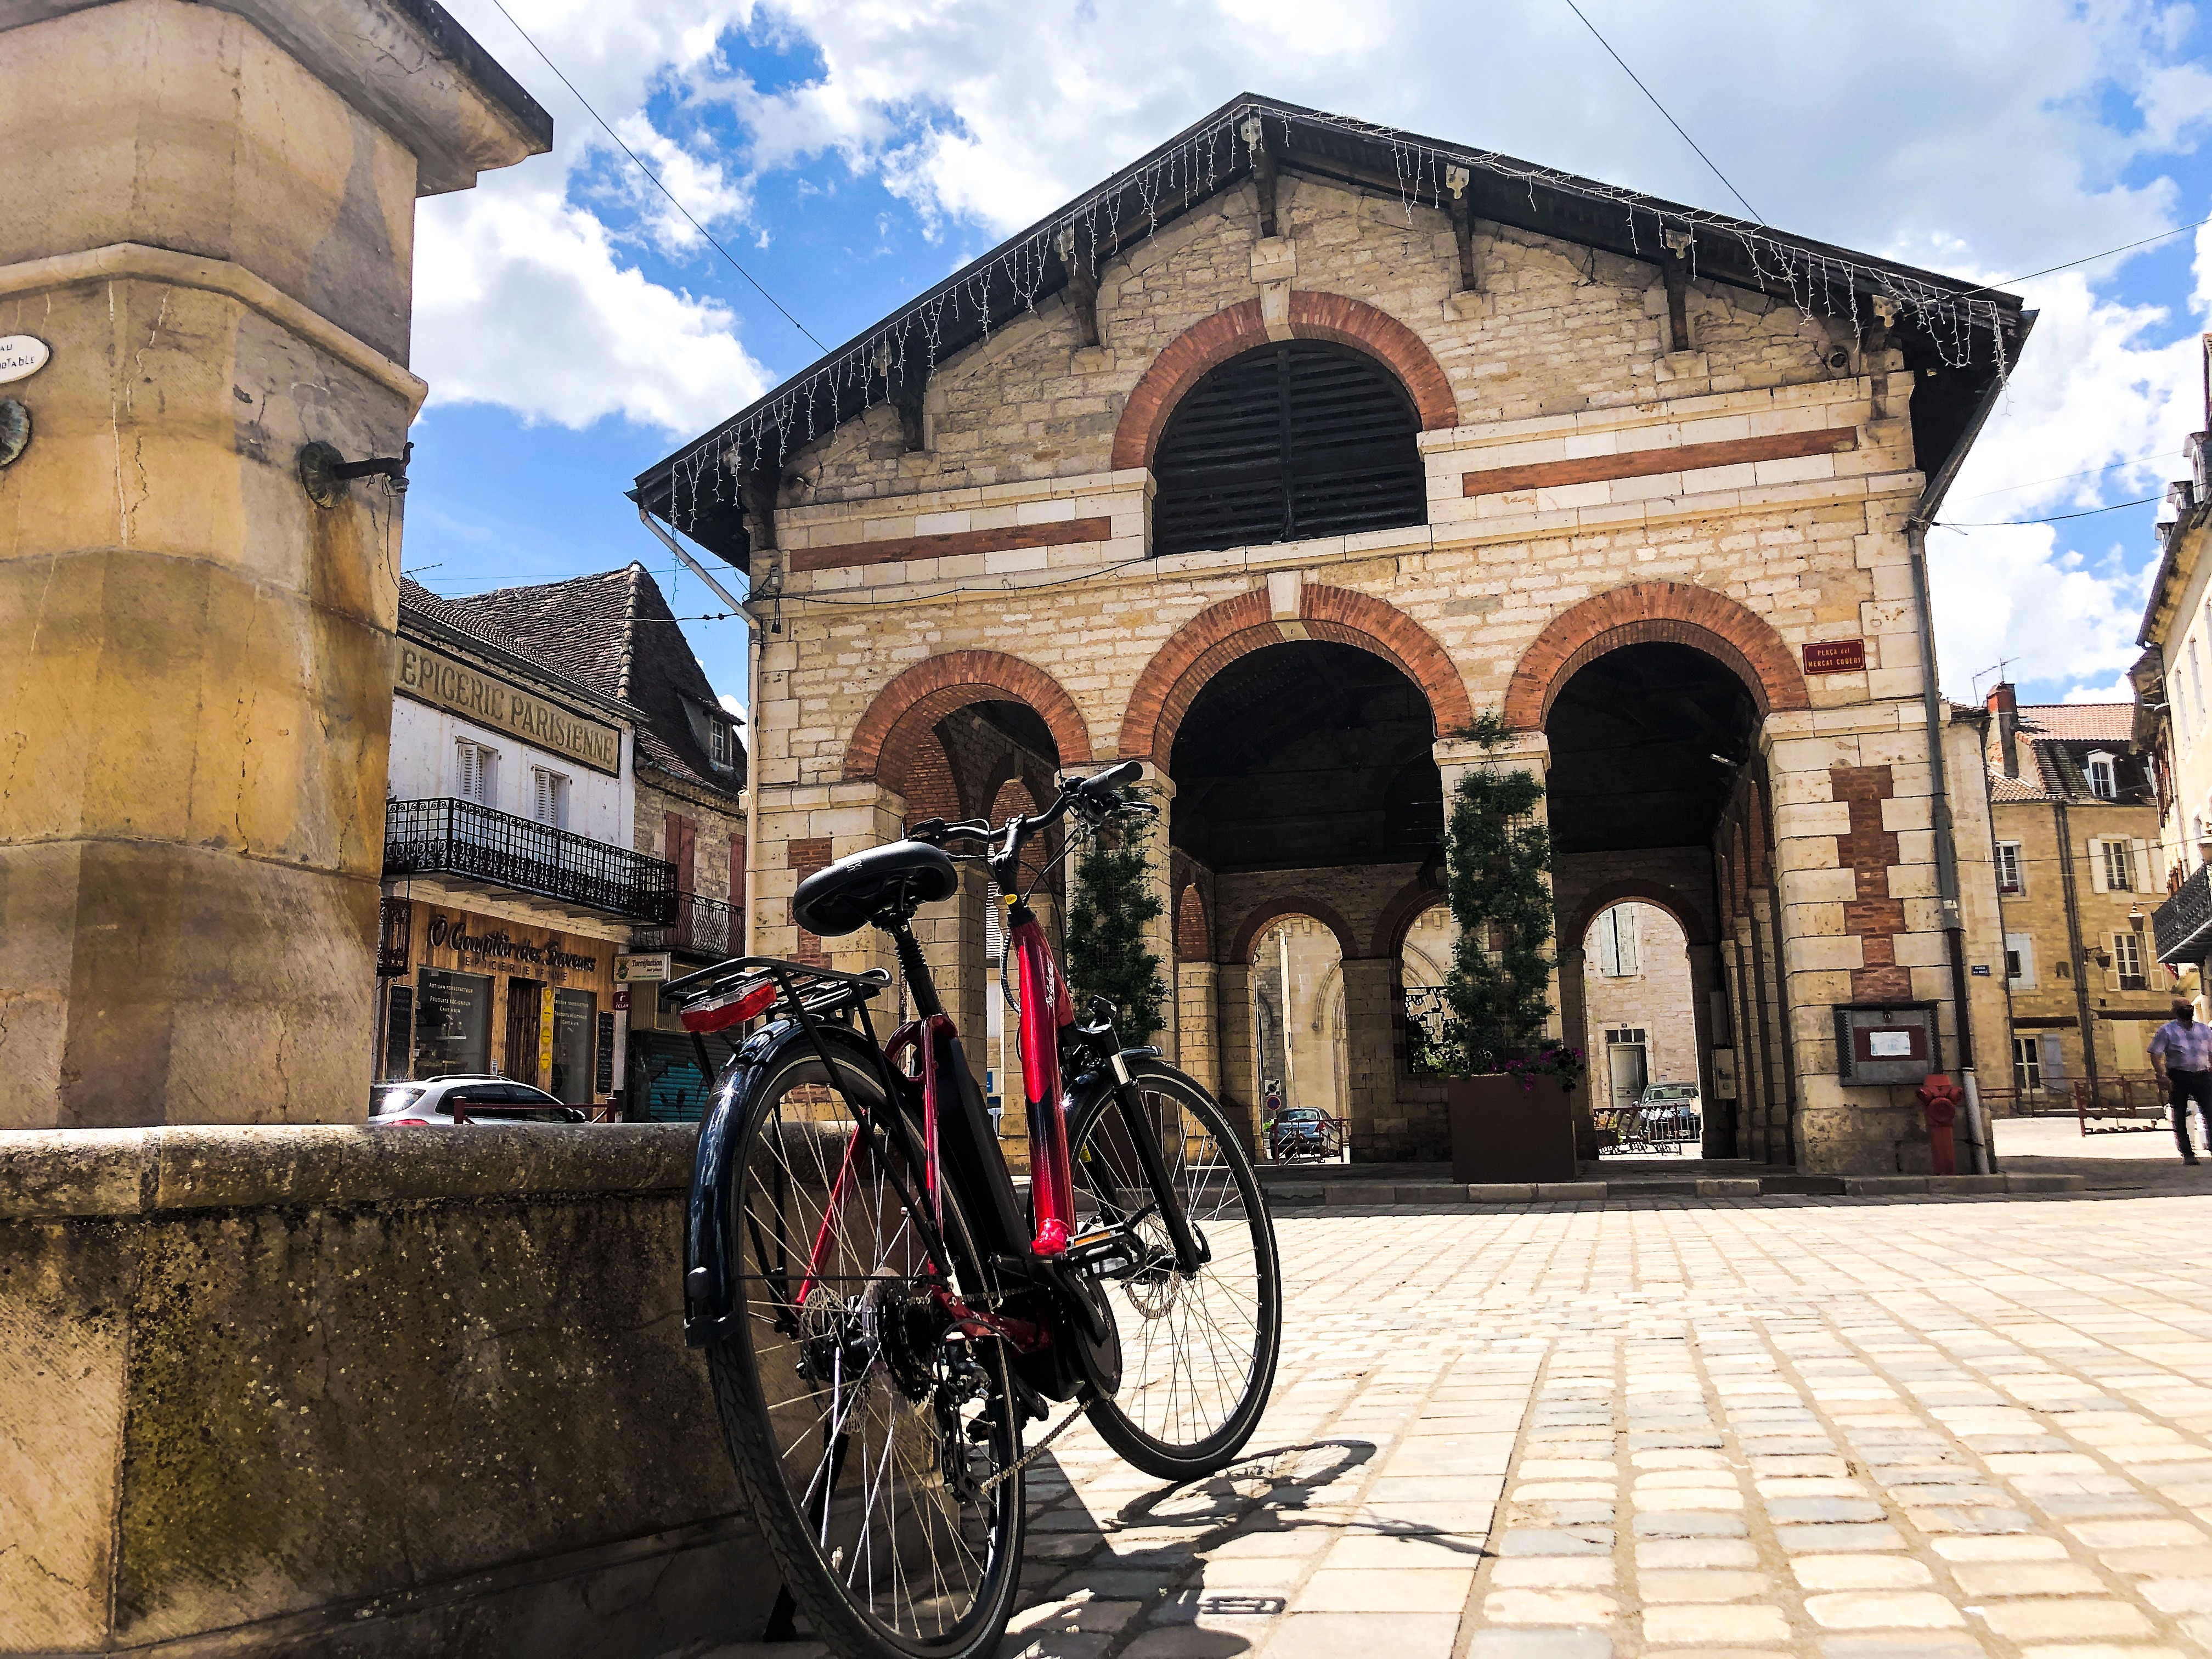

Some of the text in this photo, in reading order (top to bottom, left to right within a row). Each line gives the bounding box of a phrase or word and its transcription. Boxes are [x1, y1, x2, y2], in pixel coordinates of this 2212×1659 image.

[1817, 648, 1838, 656] PLAÇA
[509, 695, 614, 764] PARISIENNE
[449, 922, 516, 961] Comptoir
[517, 938, 541, 963] des
[543, 940, 597, 973] Saveurs
[465, 956, 568, 981] EPICERIE FINE
